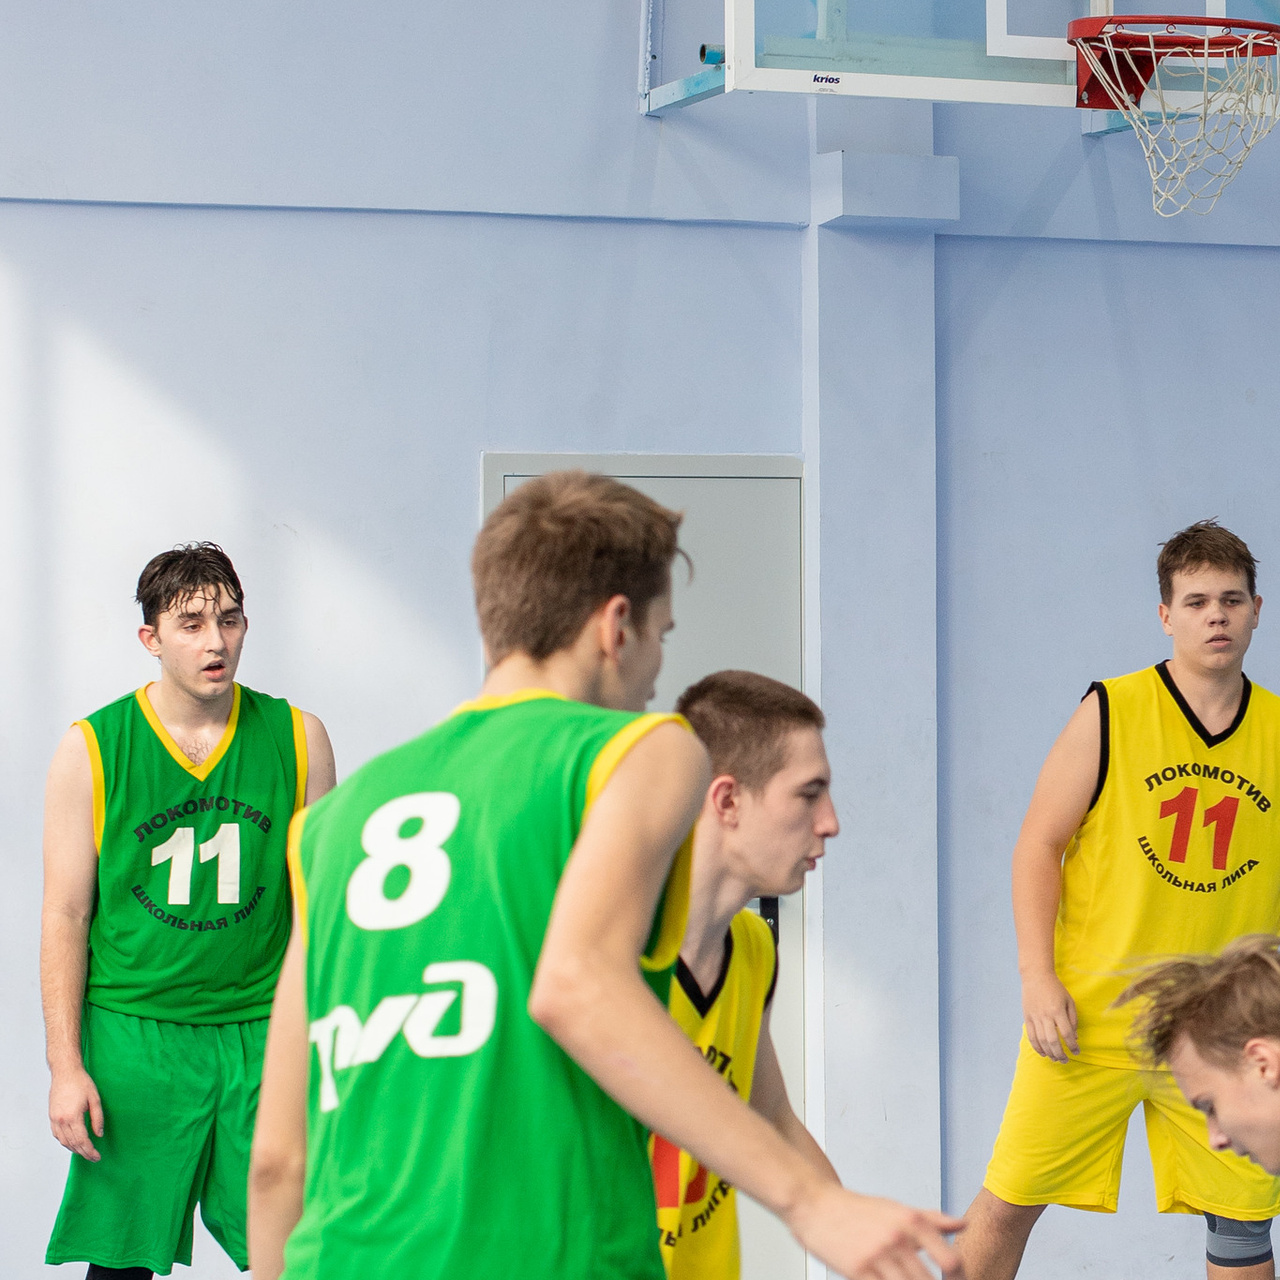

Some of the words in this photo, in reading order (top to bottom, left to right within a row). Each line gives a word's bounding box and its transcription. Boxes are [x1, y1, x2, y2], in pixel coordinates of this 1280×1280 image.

[813, 74, 840, 84] krios
[1144, 762, 1272, 813] ЛОКОМОТИВ
[133, 796, 272, 843] ЛОКОМОТИВ
[1159, 786, 1240, 870] 11
[151, 823, 241, 905] 11
[346, 791, 461, 931] 8
[1137, 836, 1217, 893] ШКОЛЬНАЯ
[1221, 858, 1260, 889] ЛИГА
[131, 884, 229, 932] ШКОЛЬНАЯ
[233, 886, 267, 924] ЛИГА
